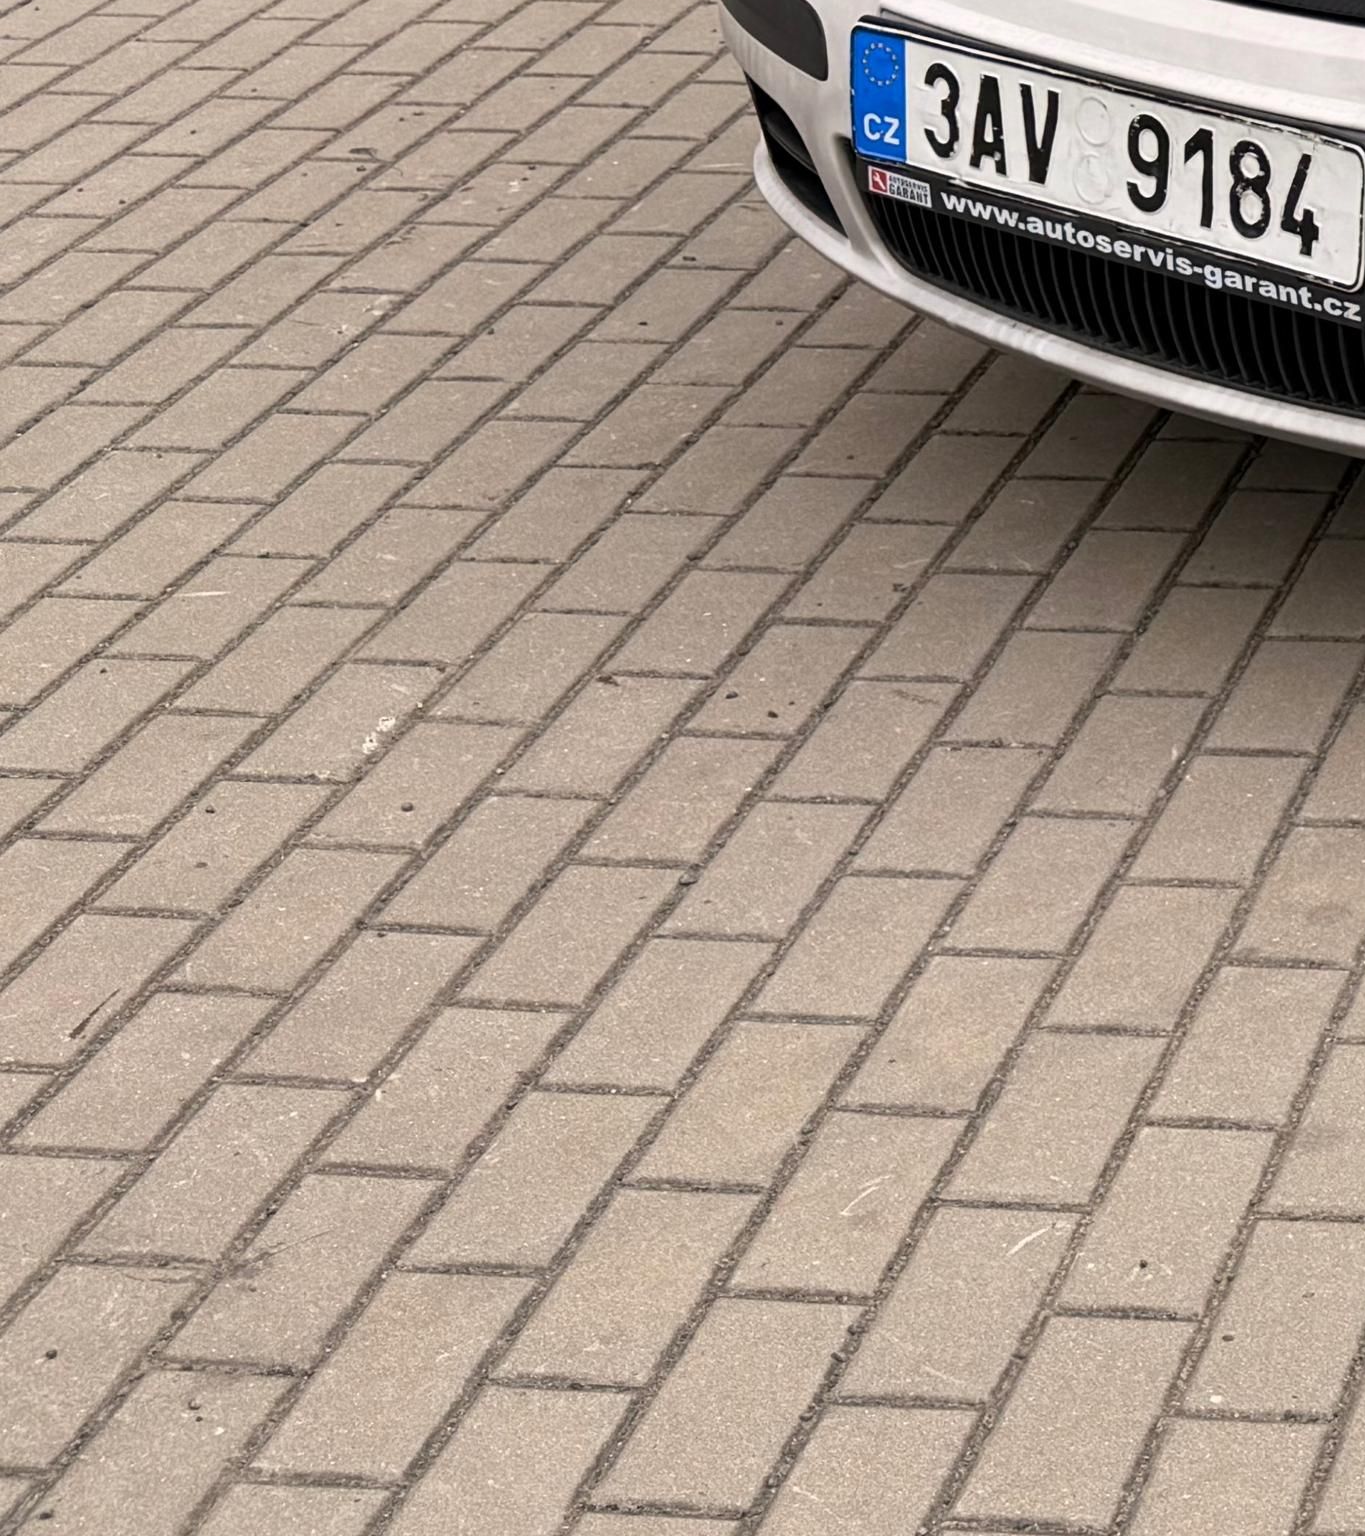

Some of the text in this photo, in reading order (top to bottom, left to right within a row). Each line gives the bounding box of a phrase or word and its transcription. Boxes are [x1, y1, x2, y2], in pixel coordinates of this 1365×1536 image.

[863, 112, 900, 145] CZ
[924, 63, 1320, 257] 3AV 9184
[889, 183, 928, 205] GARANT
[940, 191, 1362, 322] www.autoservis-garant.cz
